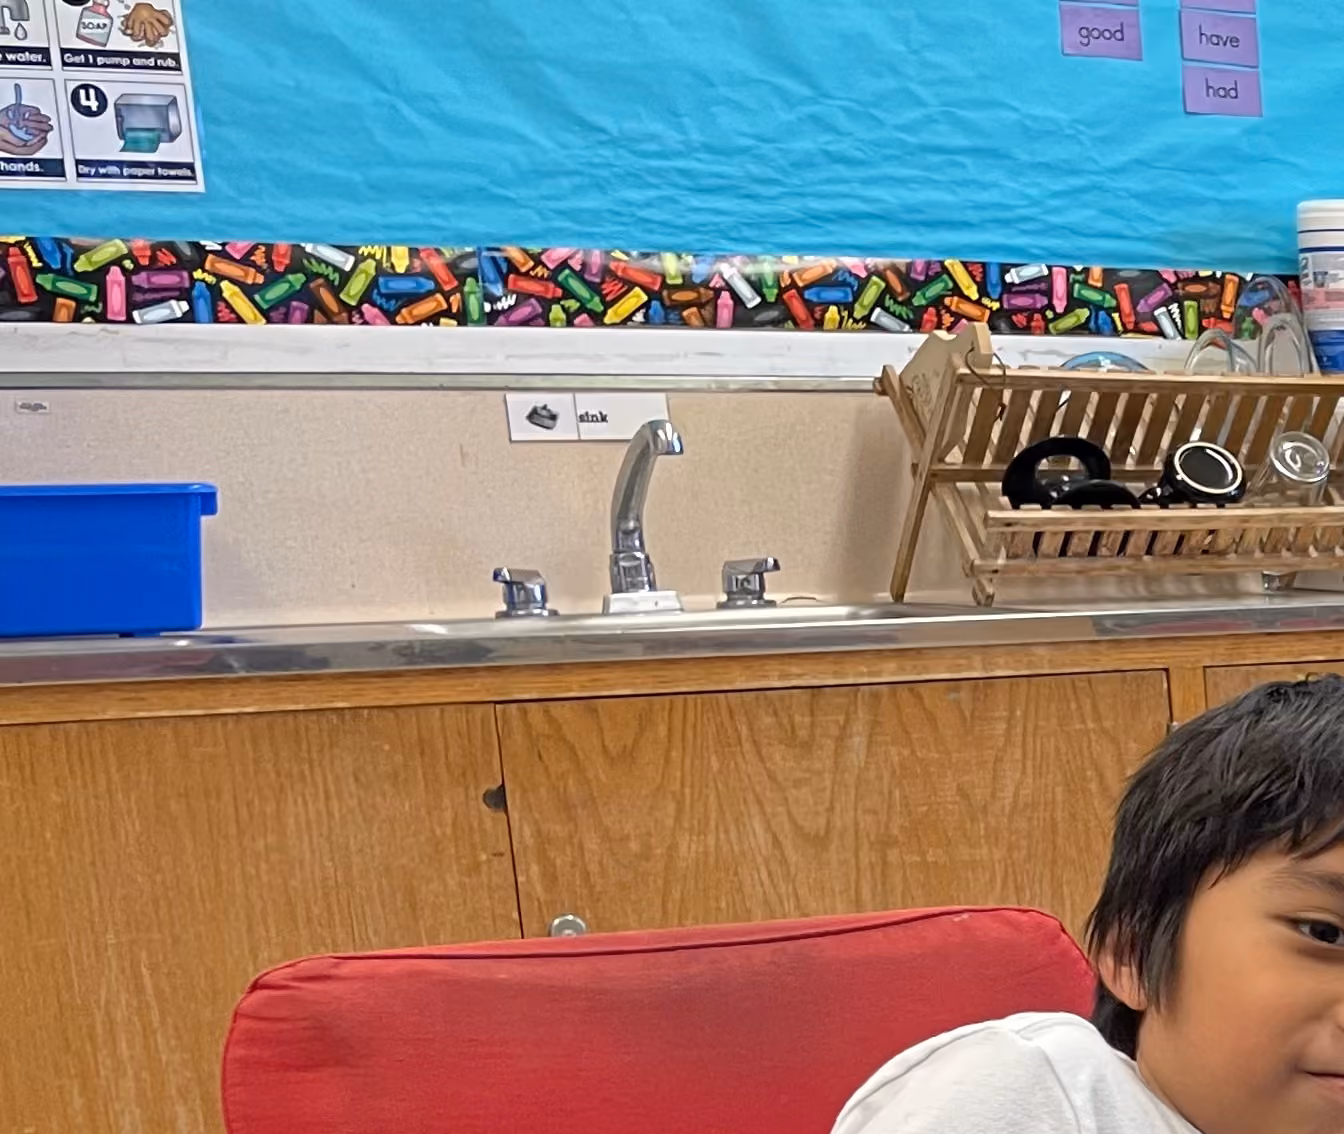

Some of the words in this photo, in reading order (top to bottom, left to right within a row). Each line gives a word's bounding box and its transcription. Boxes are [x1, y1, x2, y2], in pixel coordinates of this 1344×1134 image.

[1078, 22, 1125, 47] good
[1199, 24, 1240, 48] have
[79, 88, 99, 111] 4
[1205, 77, 1239, 99] had
[578, 411, 608, 423] sink
